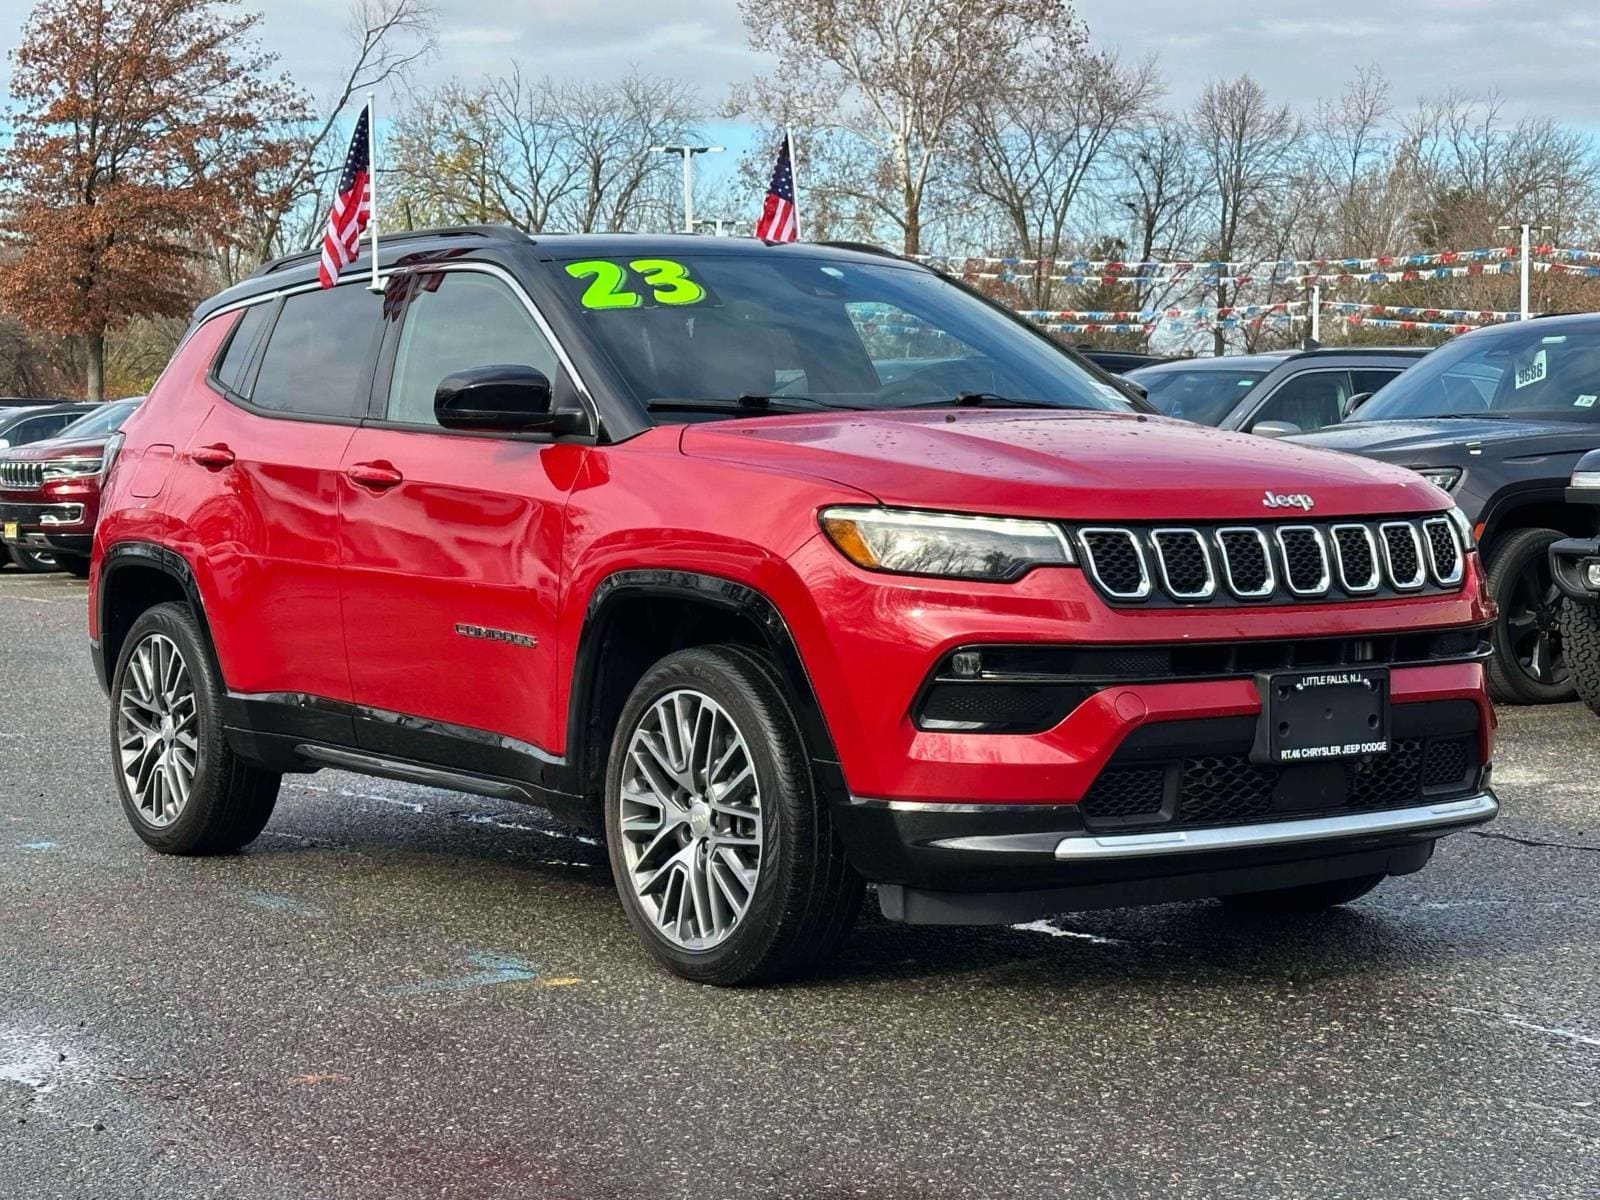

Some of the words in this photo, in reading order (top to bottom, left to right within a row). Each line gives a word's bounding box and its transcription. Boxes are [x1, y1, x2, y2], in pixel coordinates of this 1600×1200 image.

[565, 259, 706, 310] 23
[1518, 362, 1543, 384] 9686
[1262, 490, 1314, 511] Jeep
[455, 623, 537, 648] COMPASS
[1302, 677, 1325, 686] LITTLE
[1301, 746, 1341, 758] CHRYSLER
[1342, 744, 1360, 754] JEEP
[1361, 742, 1387, 753] DODGE
